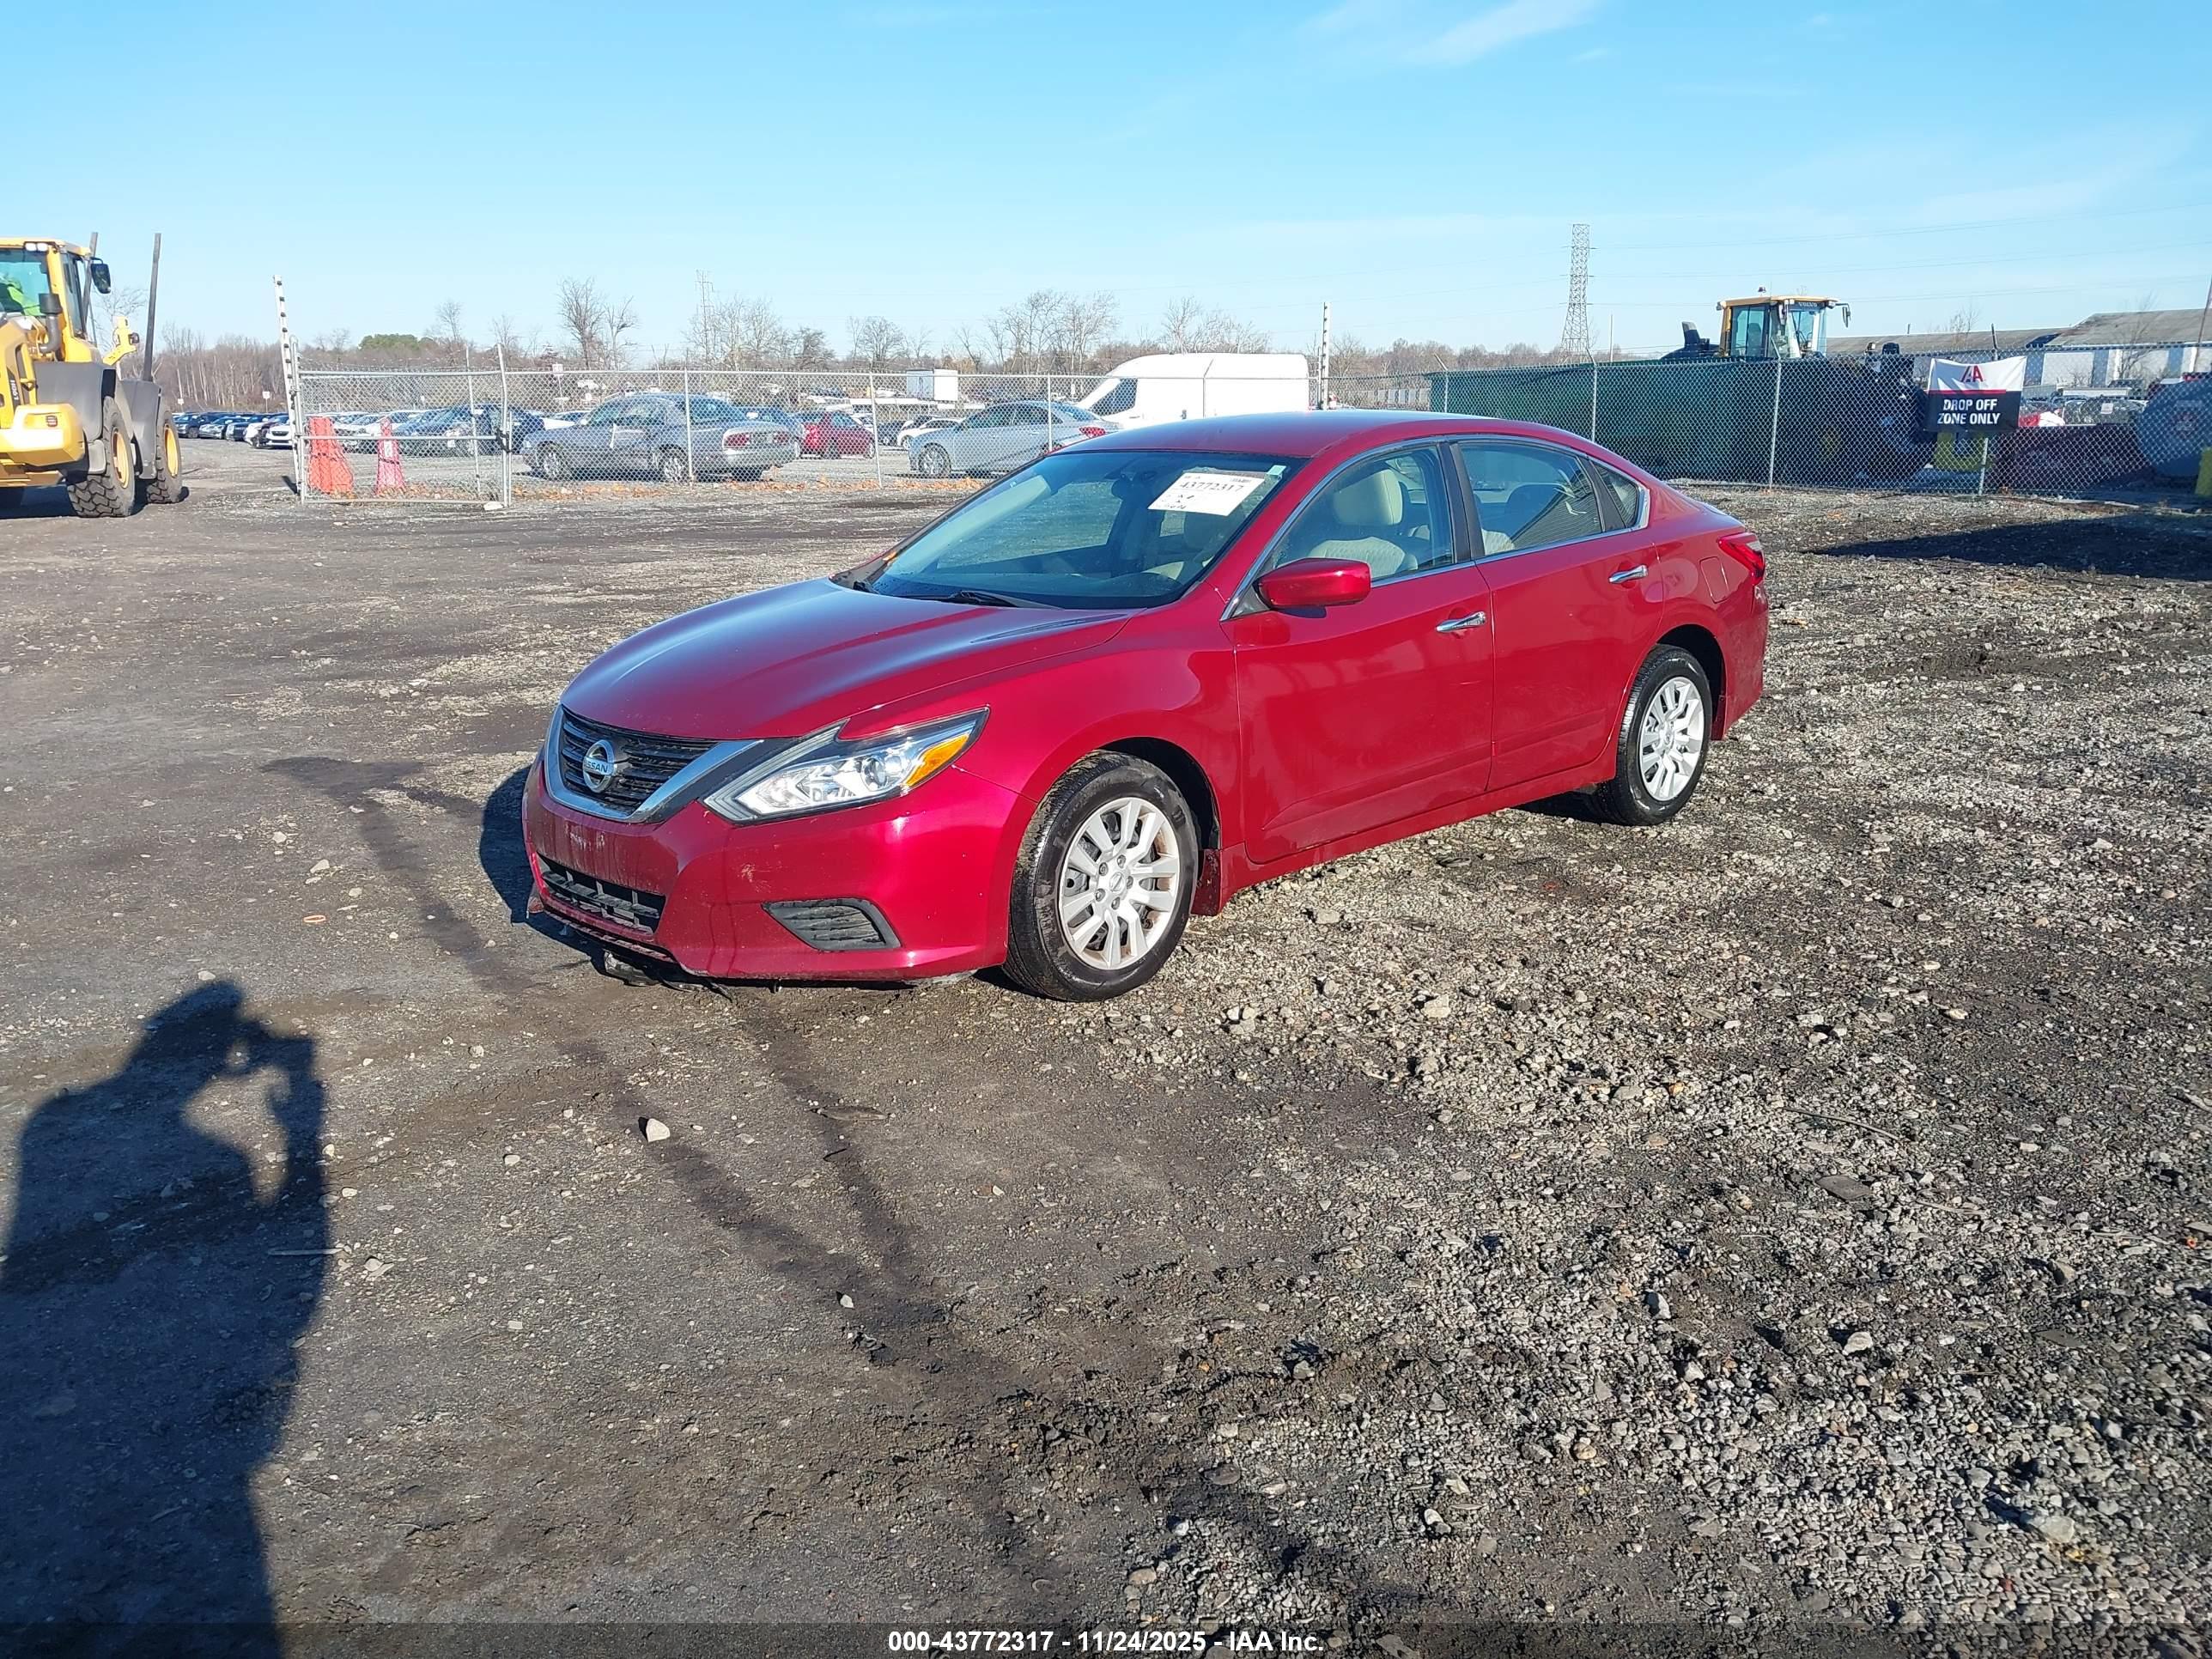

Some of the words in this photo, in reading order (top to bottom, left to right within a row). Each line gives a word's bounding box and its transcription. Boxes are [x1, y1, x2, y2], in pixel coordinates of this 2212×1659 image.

[1942, 398, 1972, 410] DROP
[1975, 398, 1998, 410] OFF
[1937, 412, 1967, 424] ZONE
[1969, 412, 2001, 424] ONLY
[1179, 481, 1244, 492] 43772317
